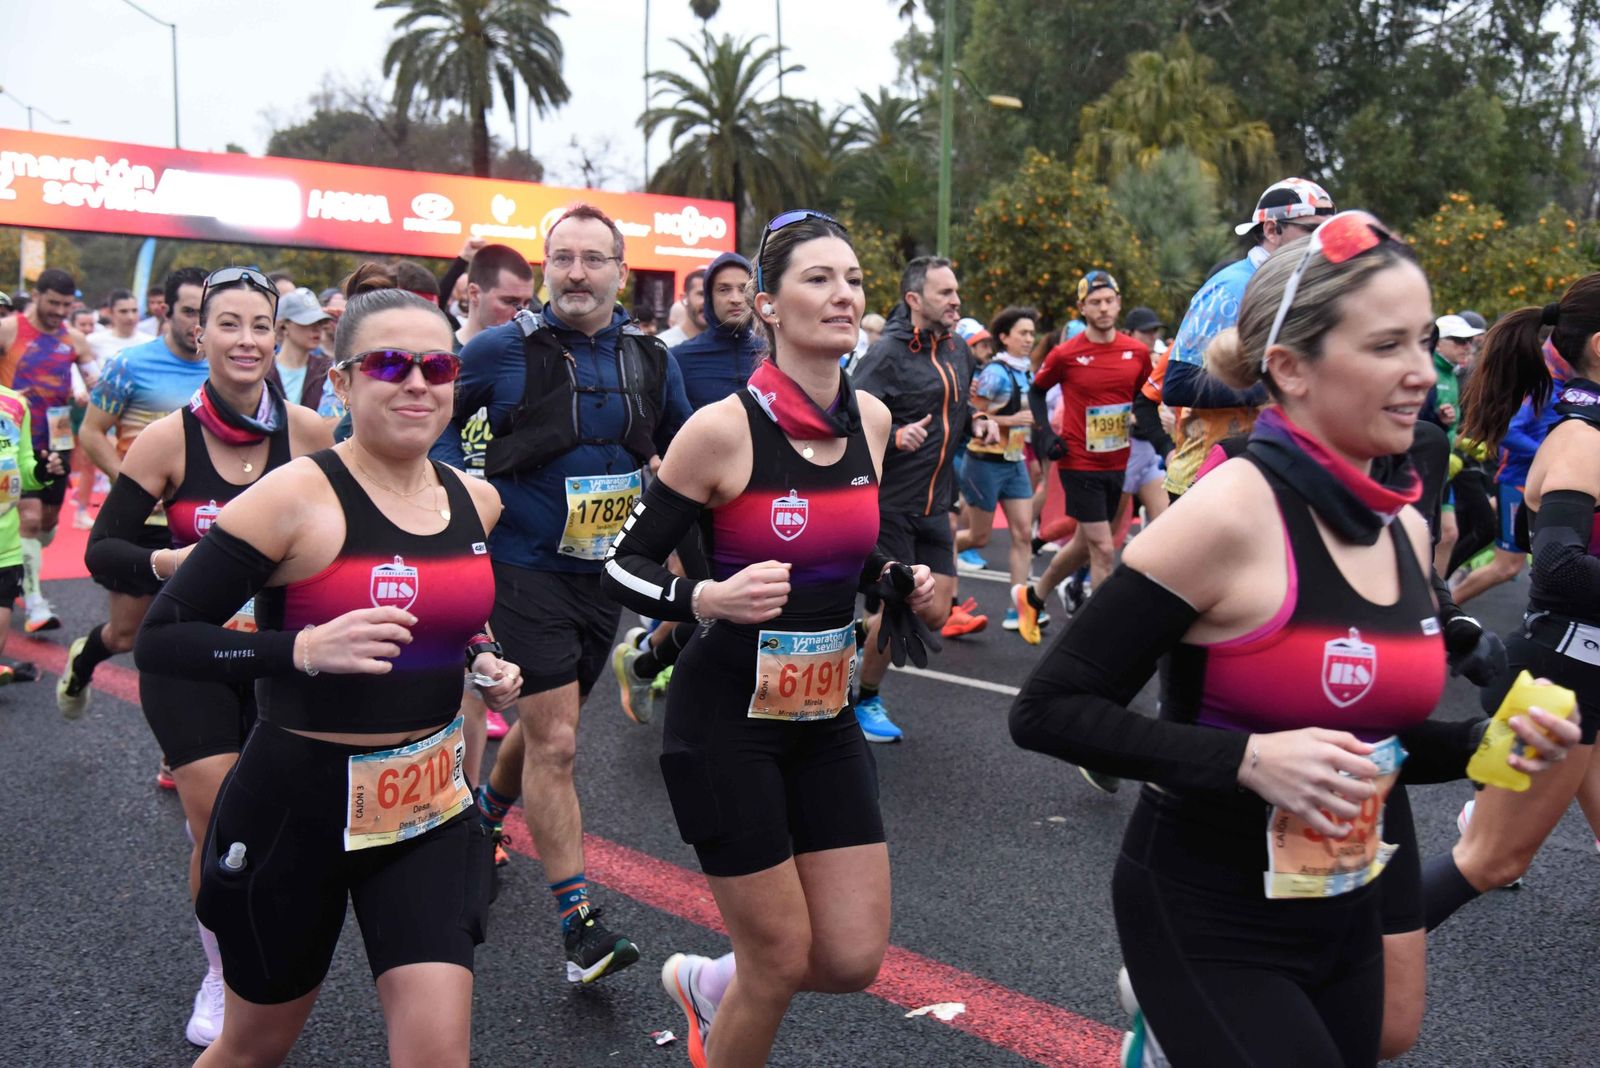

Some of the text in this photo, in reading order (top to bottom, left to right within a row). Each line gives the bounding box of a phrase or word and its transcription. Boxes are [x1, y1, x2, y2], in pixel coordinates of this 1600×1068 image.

[850, 475, 870, 486] 42K
[577, 494, 634, 524] 17828
[807, 632, 843, 645] maratón
[778, 658, 844, 699] 6191
[377, 746, 451, 810] 6210
[355, 792, 365, 819] CAJÓN
